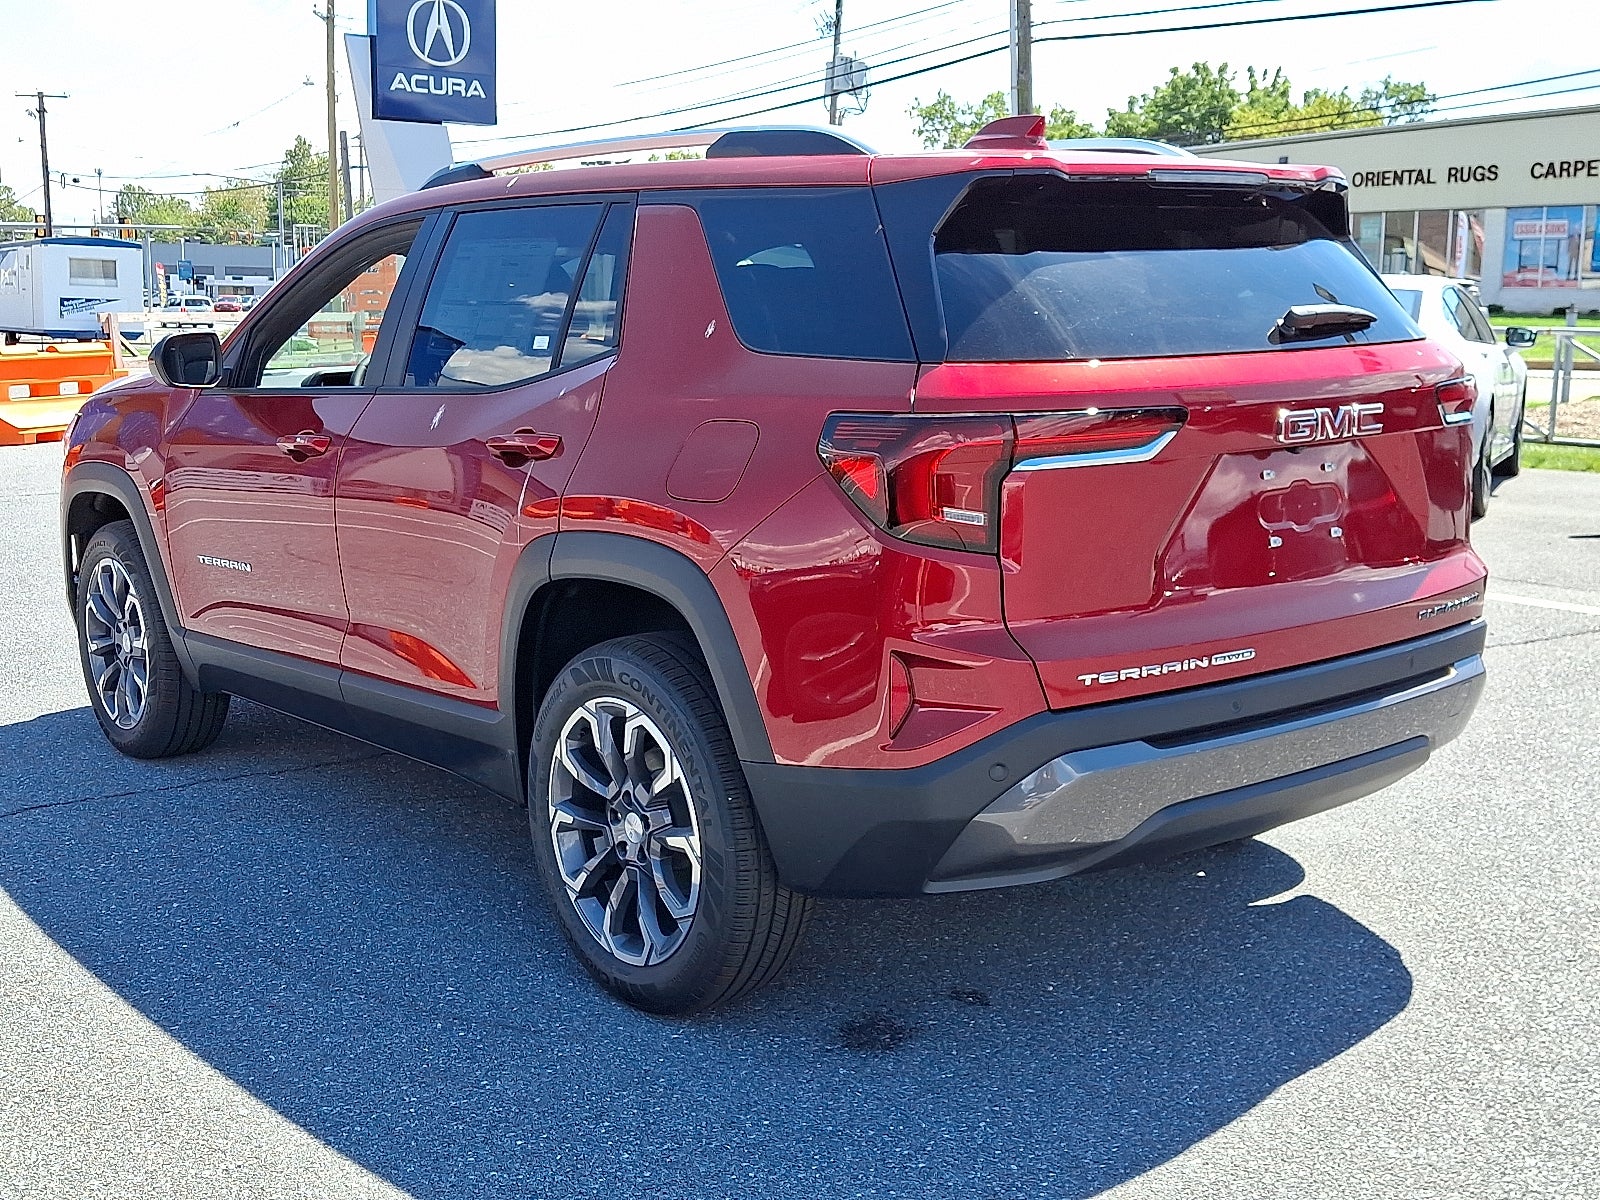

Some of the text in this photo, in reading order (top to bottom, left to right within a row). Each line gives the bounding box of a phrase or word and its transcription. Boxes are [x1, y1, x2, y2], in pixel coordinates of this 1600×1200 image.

[389, 72, 487, 99] ACURA
[1352, 164, 1499, 188] ORIENTAL RUGS
[1277, 402, 1384, 444] GMC
[197, 554, 253, 573] TERRAIN
[1077, 656, 1209, 686] TERRAIN
[618, 672, 713, 836] CONTINENTAL
